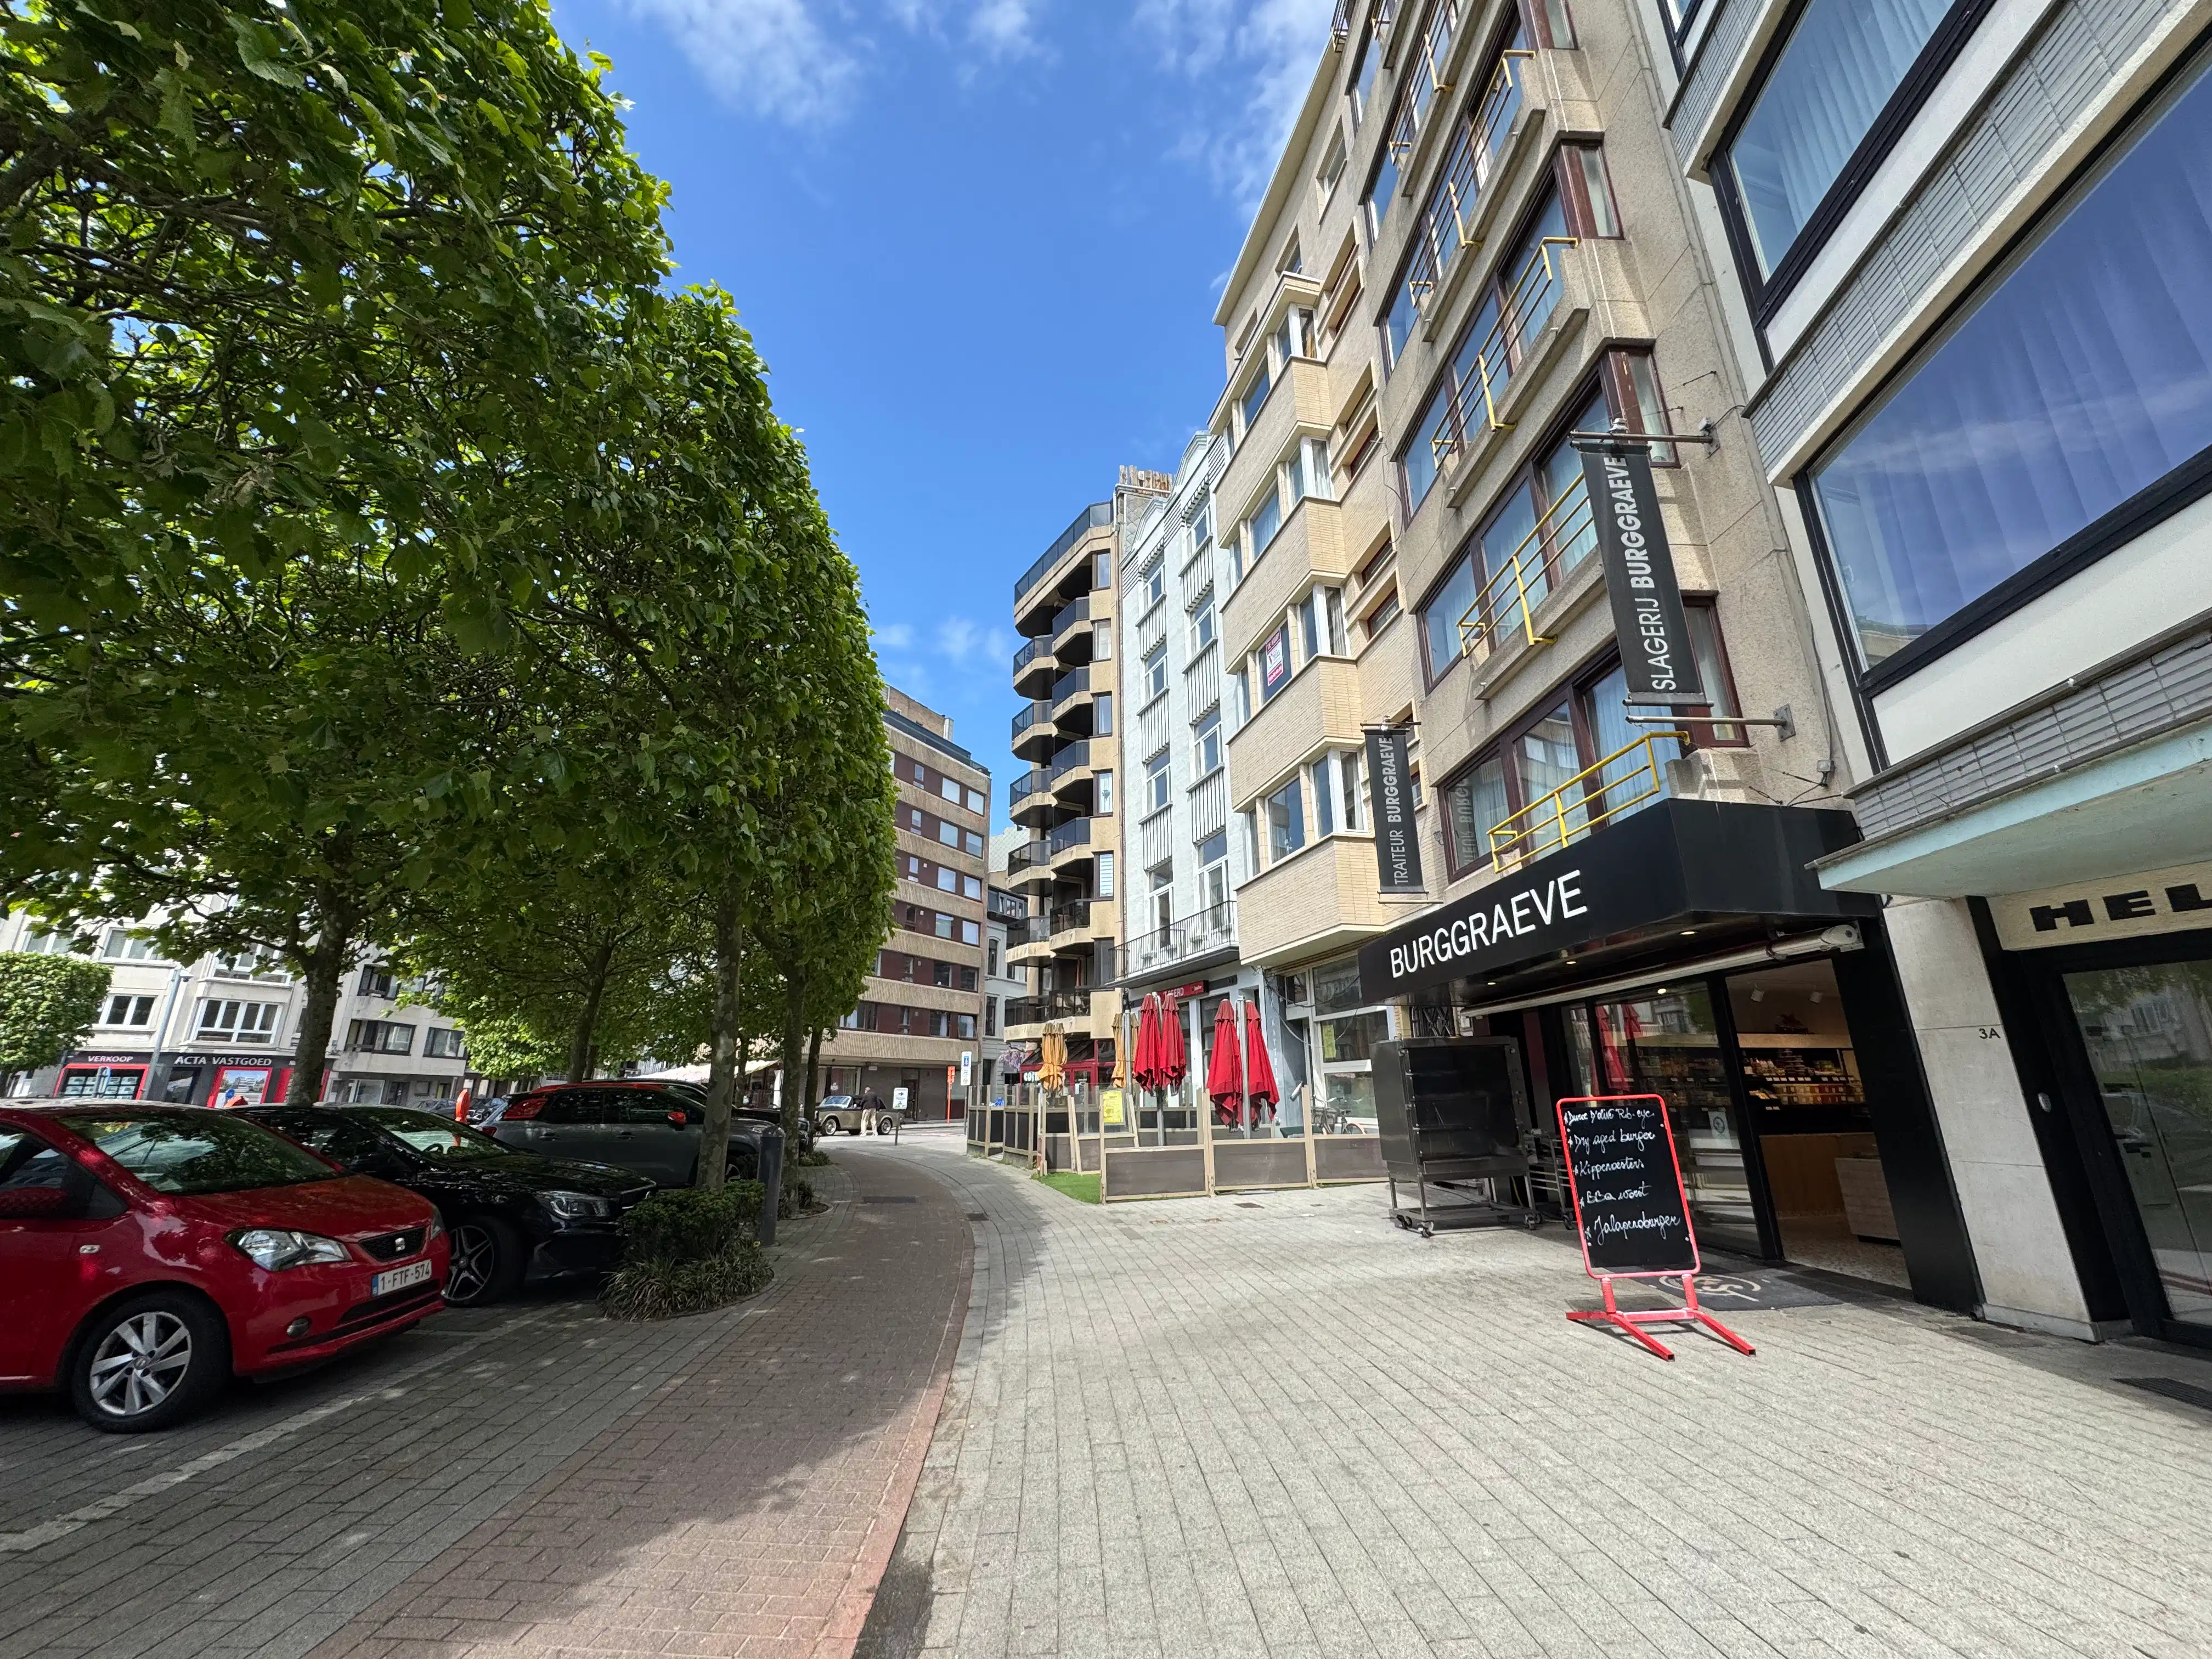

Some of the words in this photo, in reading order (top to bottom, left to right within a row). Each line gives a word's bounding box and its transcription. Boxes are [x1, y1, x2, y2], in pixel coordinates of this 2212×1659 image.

[1604, 455, 1655, 589] BURGGRAEVE
[1637, 598, 1677, 691] SLAGERIJ
[1378, 737, 1402, 822] BURGGRAEVE
[1389, 830, 1408, 885] TRAITEUR
[1390, 870, 1588, 979] BURGGRAEVE
[174, 1056, 207, 1065] ACTA
[212, 1057, 273, 1066] VASTGOED
[1978, 1028, 2001, 1040] 3A
[1574, 1133, 1590, 1155] Dry
[1592, 1130, 1616, 1154] aged
[1620, 1128, 1656, 1152] burger
[1617, 1181, 1652, 1200] worst
